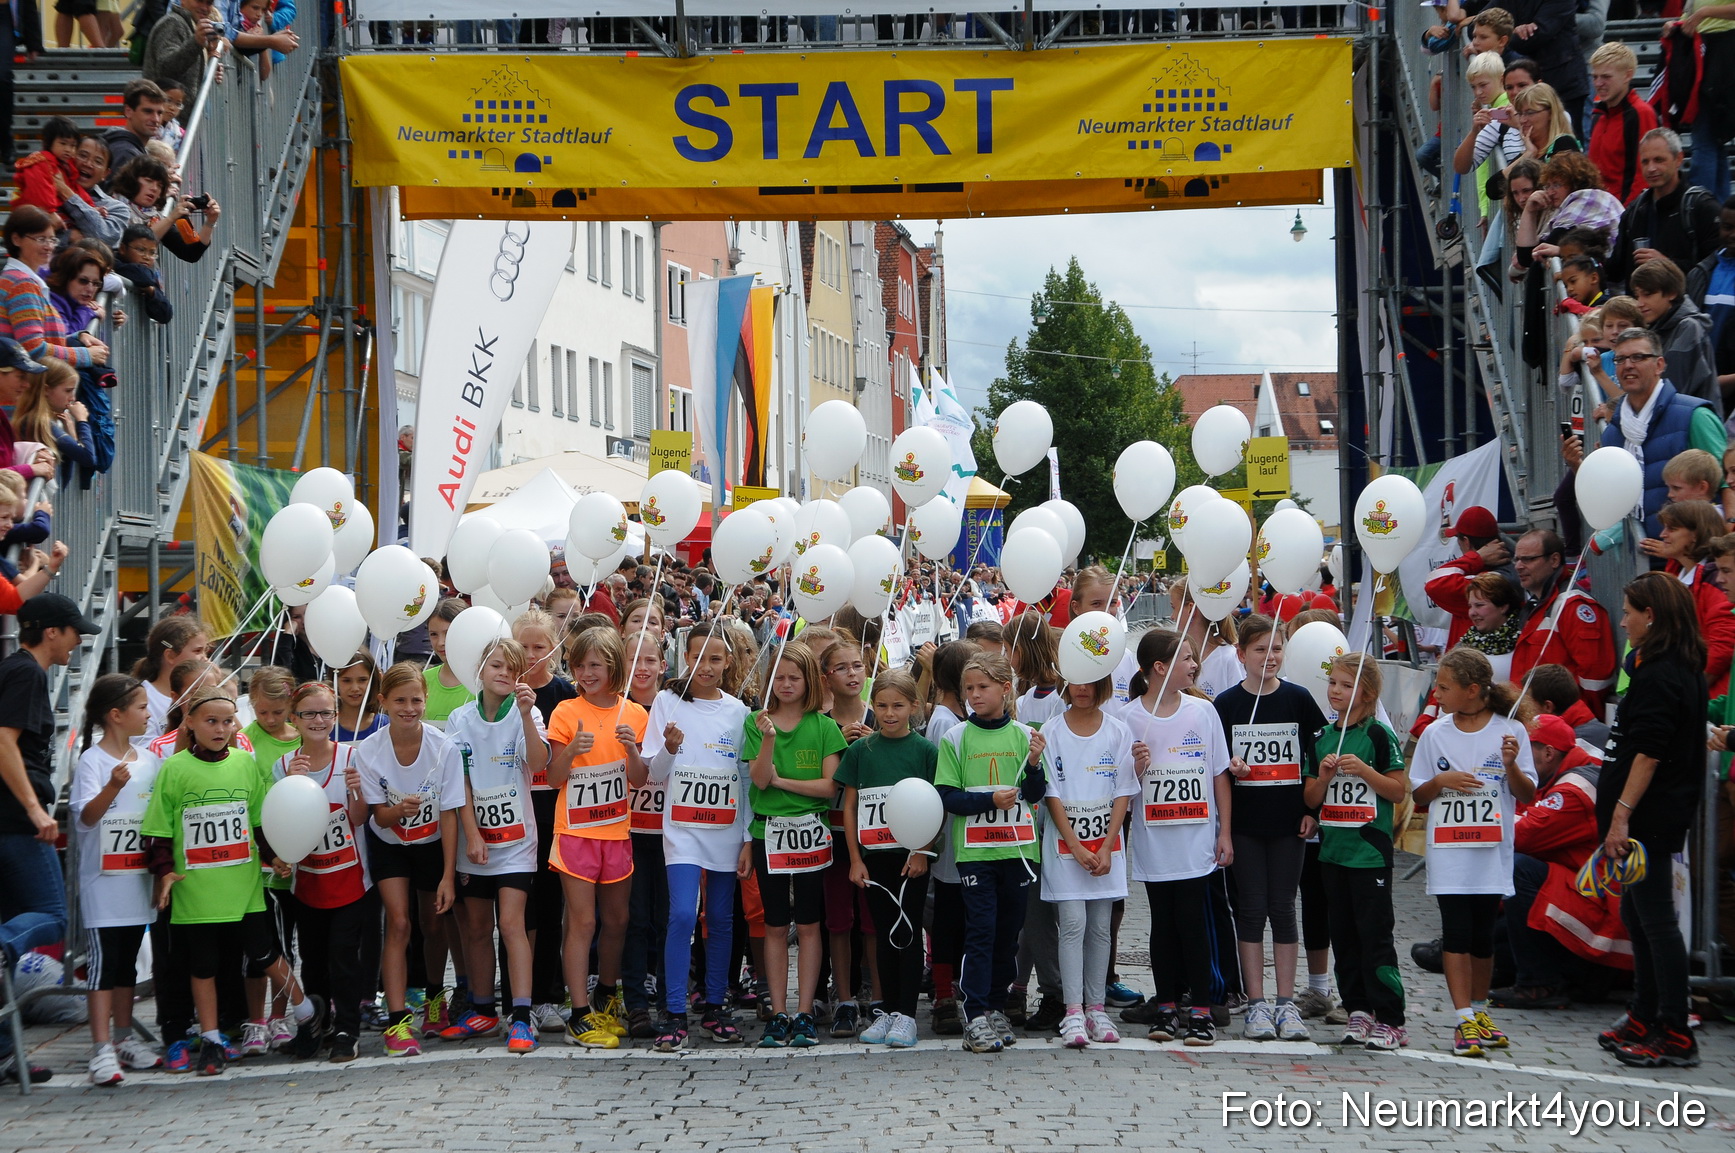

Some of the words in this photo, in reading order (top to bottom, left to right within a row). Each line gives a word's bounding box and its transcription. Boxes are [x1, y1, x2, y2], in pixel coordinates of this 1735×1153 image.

[672, 78, 1014, 163] START
[1077, 115, 1196, 135] Neumarkter
[1200, 113, 1293, 132] Stadtlauf
[397, 125, 516, 144] Neumarkter
[520, 126, 612, 145] Stadtlauf
[437, 415, 477, 512] Audi
[461, 325, 499, 409] BKK
[651, 446, 691, 459] Jugend-
[1248, 453, 1287, 464] Jugend-
[661, 459, 680, 469] lauf
[1259, 465, 1278, 475] lauf
[1234, 730, 1256, 738] PARTL
[1240, 740, 1294, 764] 7394
[590, 768, 619, 778] Neumarkt
[700, 773, 730, 781] Neumarkt
[476, 792, 507, 802] Neumarkt
[573, 777, 624, 806] 7170
[680, 781, 730, 805] 7001
[860, 793, 880, 801] PARTL
[1150, 778, 1201, 803] 7280
[1330, 781, 1367, 804] 182
[630, 789, 665, 812] 729
[476, 802, 515, 827] 285
[589, 807, 616, 820] Merle
[865, 801, 888, 826] 70
[1081, 803, 1108, 813] Neumarkt
[1151, 806, 1204, 818] Anna-Maria
[1324, 807, 1366, 820] Cassandra
[1441, 800, 1494, 823] 7012
[102, 818, 127, 826] PARTL
[693, 810, 716, 821] Julia
[189, 817, 242, 845] 7018
[1067, 813, 1111, 840] 7335
[315, 826, 345, 851] 13
[772, 825, 826, 851] 7002
[877, 831, 894, 842] Sve
[984, 829, 1015, 840] Janika
[1453, 829, 1481, 839] Laura
[211, 849, 229, 860] Eva
[785, 855, 819, 866] Jasmin
